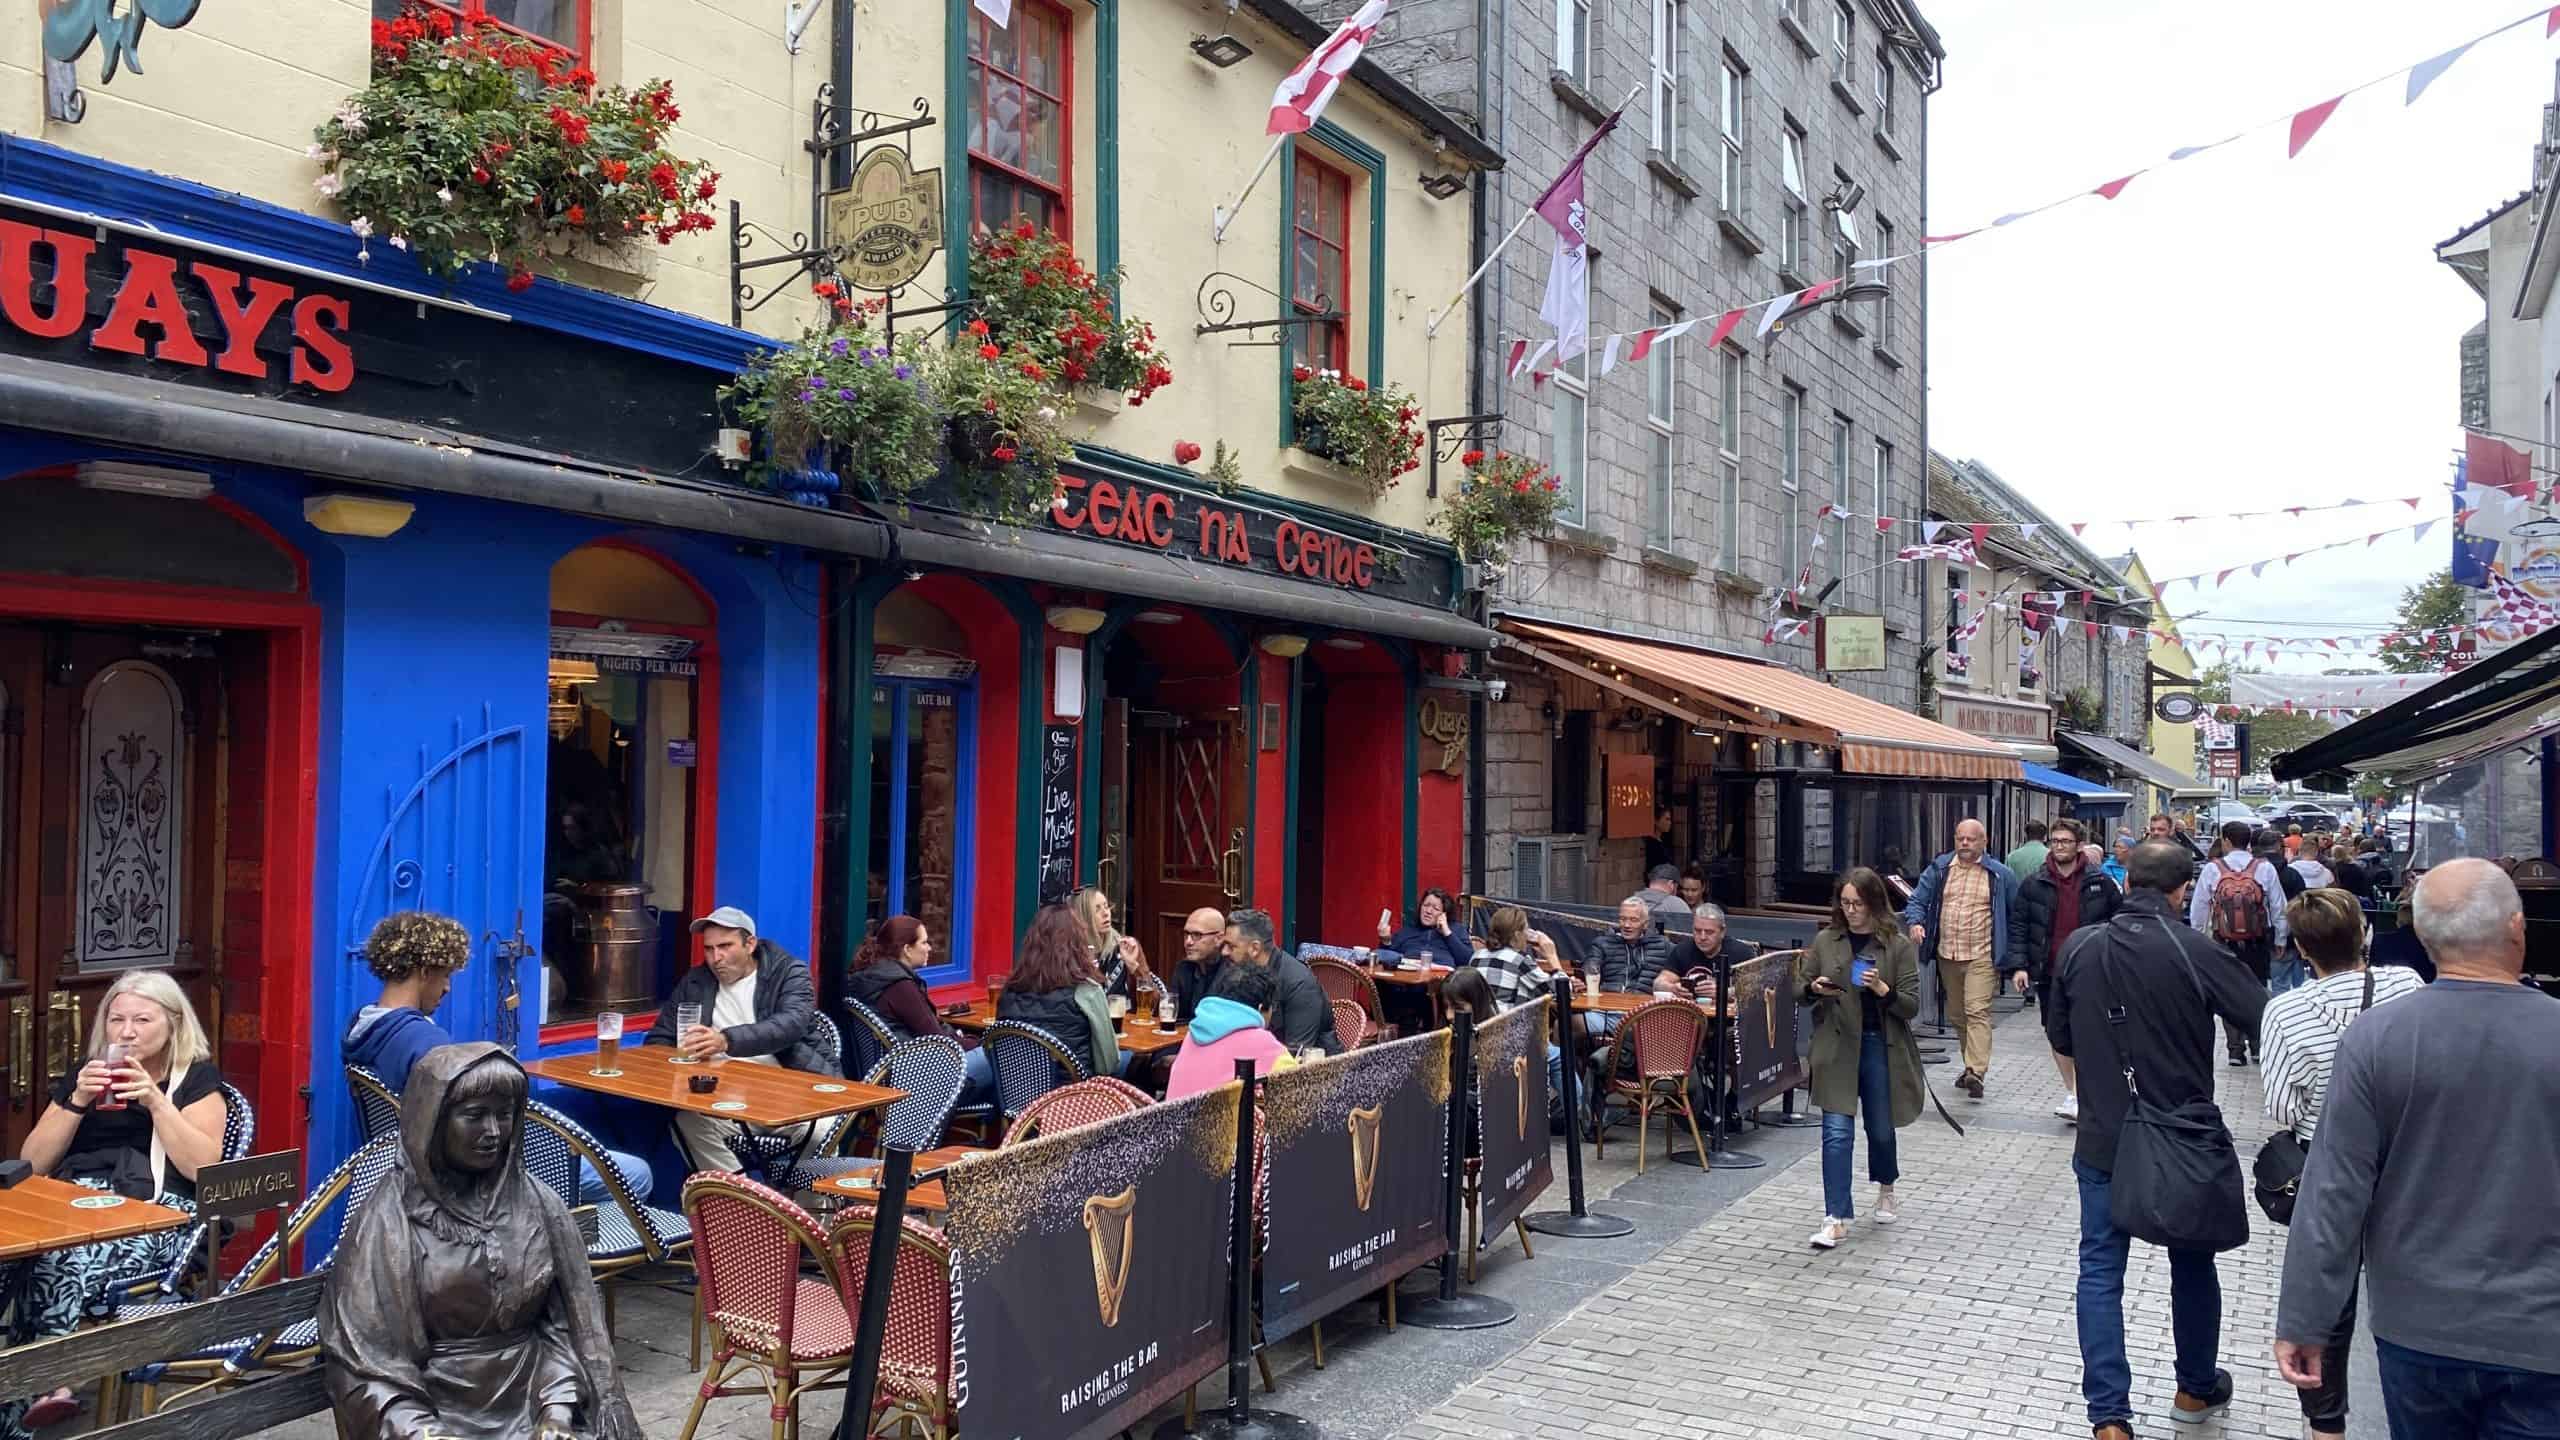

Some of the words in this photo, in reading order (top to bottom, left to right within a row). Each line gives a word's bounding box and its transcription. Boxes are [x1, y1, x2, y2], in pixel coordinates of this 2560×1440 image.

[852, 198, 914, 239] PUB
[864, 246, 902, 262] AWARD
[602, 656, 641, 672] NIGHTS
[646, 660, 665, 674] PER
[670, 662, 697, 676] WEEK
[2451, 651, 2480, 660] COST
[1045, 785, 1070, 813] Live
[1044, 814, 1075, 852] Music
[1042, 854, 1051, 882] 7
[203, 1175, 262, 1204] GALWAY
[264, 1169, 296, 1192] GIRL
[1328, 1243, 1362, 1270] RAISING
[1364, 1235, 1379, 1254] THE
[1380, 1228, 1396, 1247] BAR
[949, 1248, 969, 1409] GUINNESS
[1061, 1370, 1109, 1414] RAISING
[1113, 1355, 1135, 1382] THE
[1138, 1341, 1159, 1368] BAR
[1097, 1379, 1129, 1408] GUINNESS
